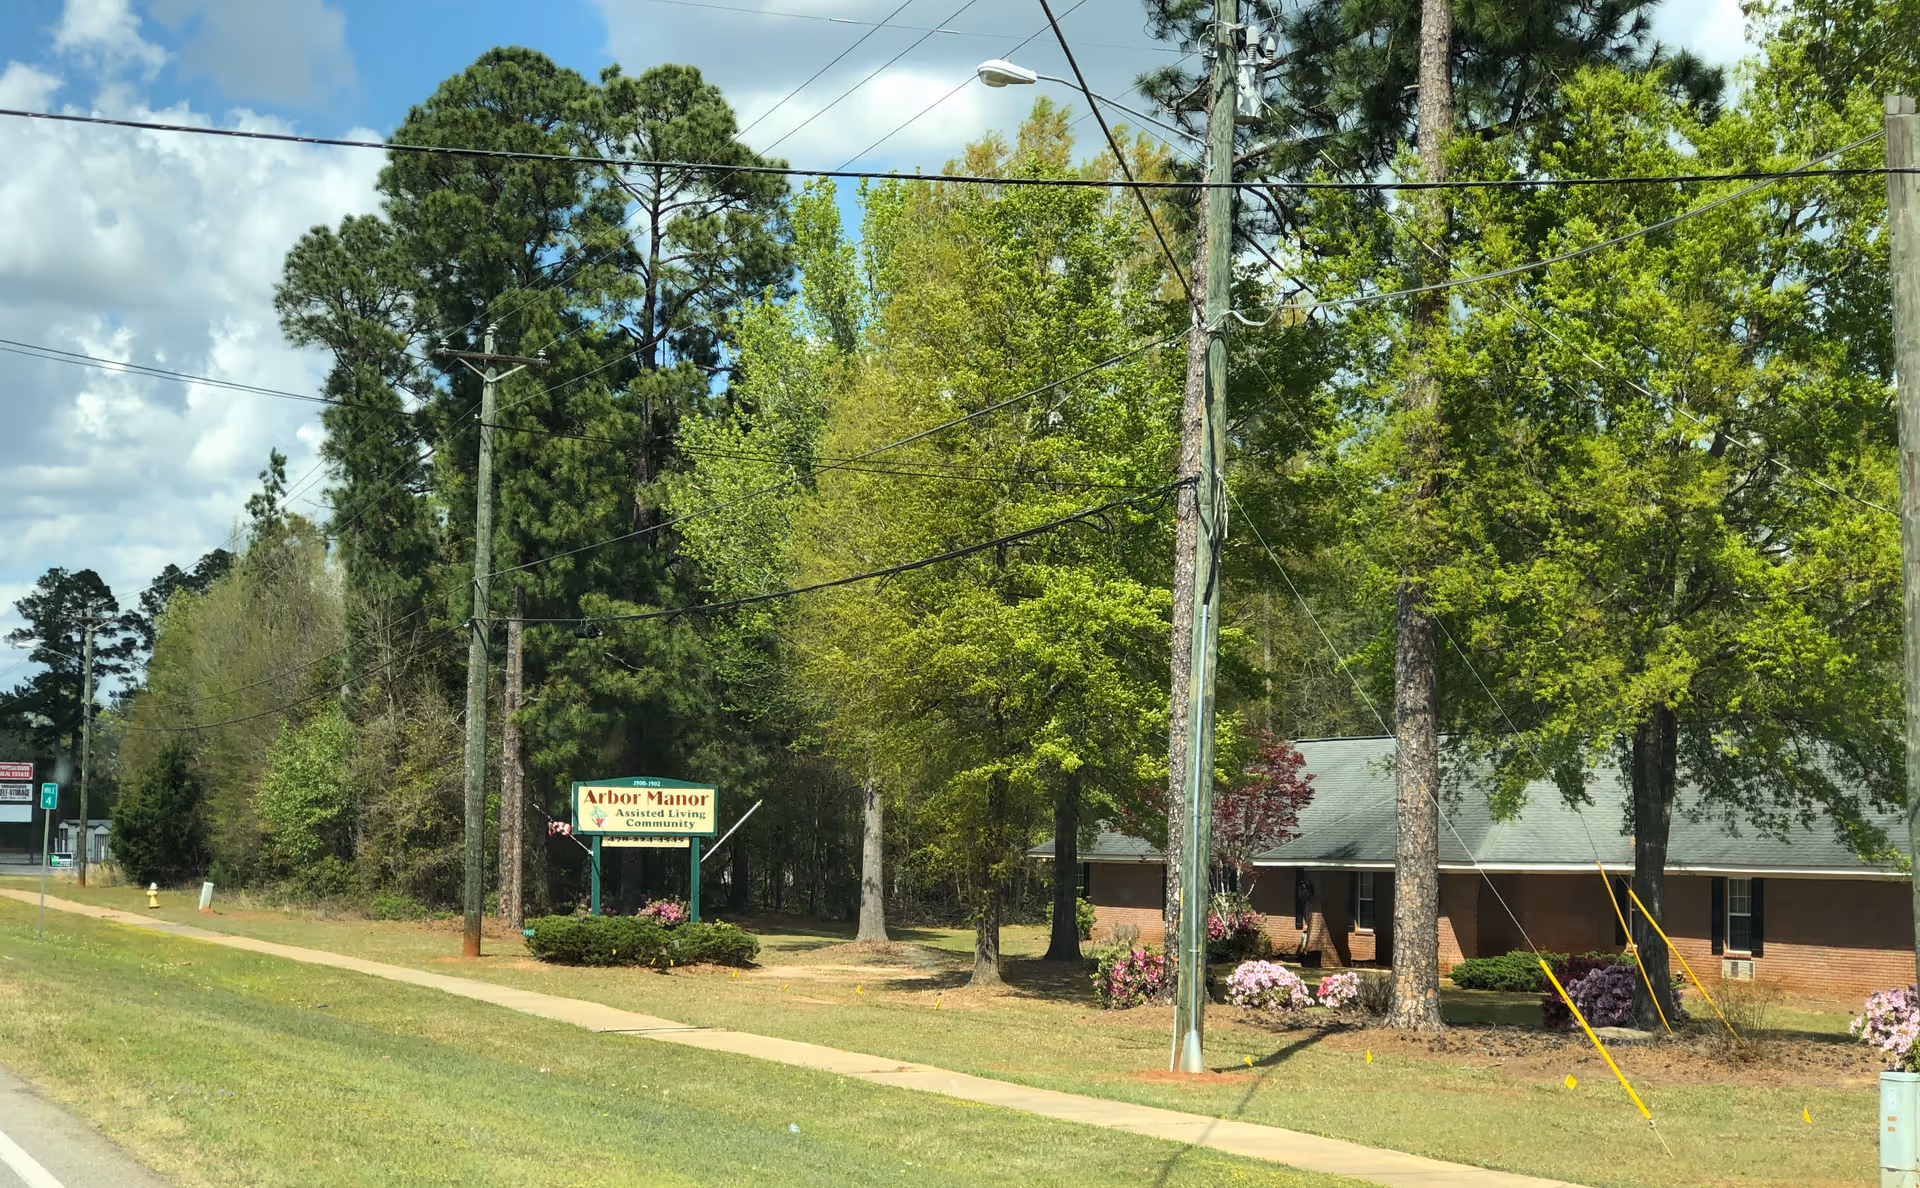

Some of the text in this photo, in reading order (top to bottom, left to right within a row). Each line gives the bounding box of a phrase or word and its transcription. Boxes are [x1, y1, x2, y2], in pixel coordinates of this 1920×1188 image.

[44, 787, 56, 795] MILE
[45, 796, 52, 806] 4
[583, 789, 709, 806] Arbor Manor
[615, 808, 706, 820] Assisted Living
[626, 818, 696, 829] Community
